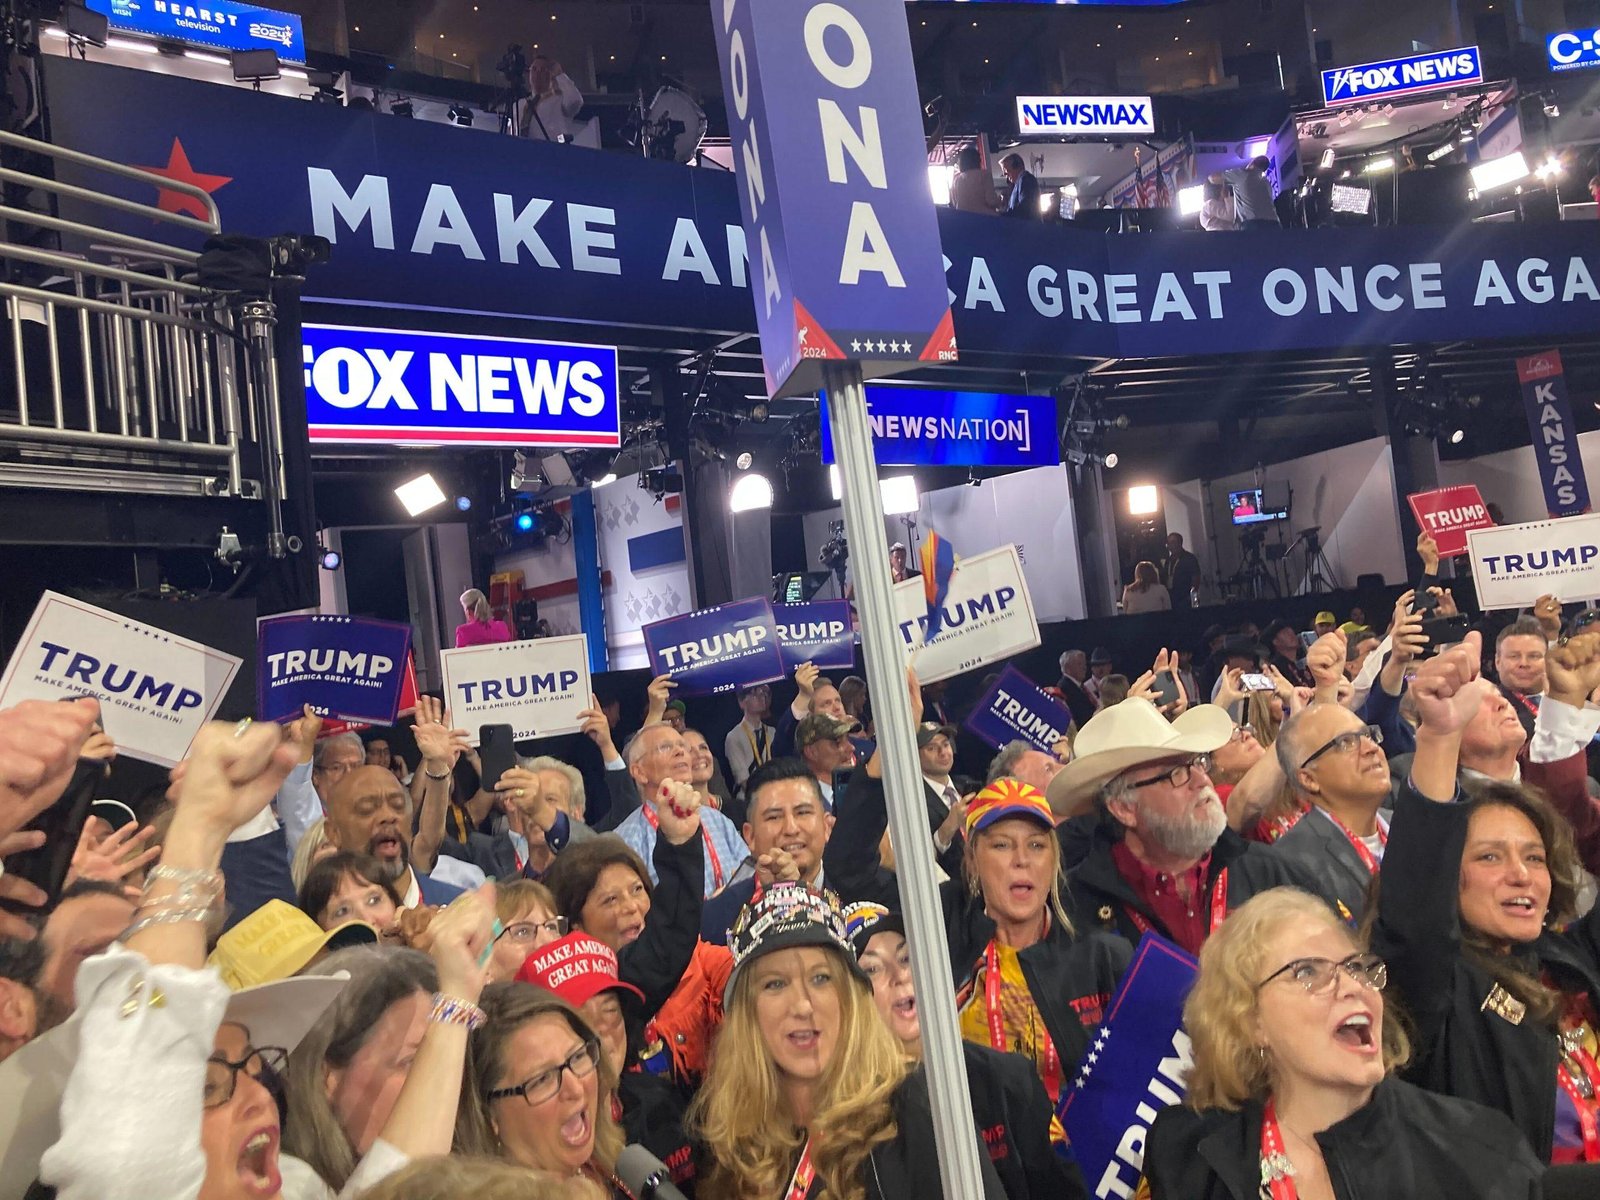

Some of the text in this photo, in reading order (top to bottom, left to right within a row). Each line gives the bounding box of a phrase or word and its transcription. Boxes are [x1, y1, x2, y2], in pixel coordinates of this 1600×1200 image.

[112, 8, 132, 17] WISN
[154, 0, 237, 26] HEARST
[175, 17, 221, 34] television
[249, 23, 286, 38] 2024
[1349, 53, 1474, 93] FOX NEWS
[1022, 103, 1148, 126] NEWSMAX
[307, 166, 622, 275] MAKE
[1027, 264, 1232, 323] GREAT
[1262, 262, 1446, 317] ONCE
[802, 347, 827, 359] 2024
[429, 351, 605, 417] NEWS
[1534, 382, 1577, 506] KANSAS
[1424, 504, 1485, 528] TRUMP
[1482, 545, 1599, 575] TRUMP
[1512, 572, 1543, 580] AMERICA
[899, 587, 1016, 644] TUMP
[776, 621, 845, 641] RUMP
[931, 630, 964, 646] AMERICA
[965, 622, 988, 633] GREAT
[659, 625, 767, 668] TRUMP
[267, 649, 393, 679] TRUMP
[669, 647, 766, 674] MAKE AMERICA GREAT AGAIN!
[959, 657, 983, 671] 2024
[40, 641, 203, 712] TRUMP
[271, 673, 382, 688] MAKE AMERICA GREAT AGAIN!
[458, 670, 578, 704] TRUMP
[713, 683, 736, 693] 2024
[34, 674, 62, 688] MAKE
[114, 699, 148, 713] GREAT
[149, 709, 183, 725] AGAIN!
[310, 706, 329, 716] 024
[466, 693, 575, 712] MAKE AMERICA GREAT AGAIN!
[993, 689, 1060, 744] TRUMP
[513, 730, 536, 738] 2024
[532, 943, 574, 974] MAKE
[547, 959, 590, 989] GREAT
[1096, 1029, 1195, 1200] TRUM
